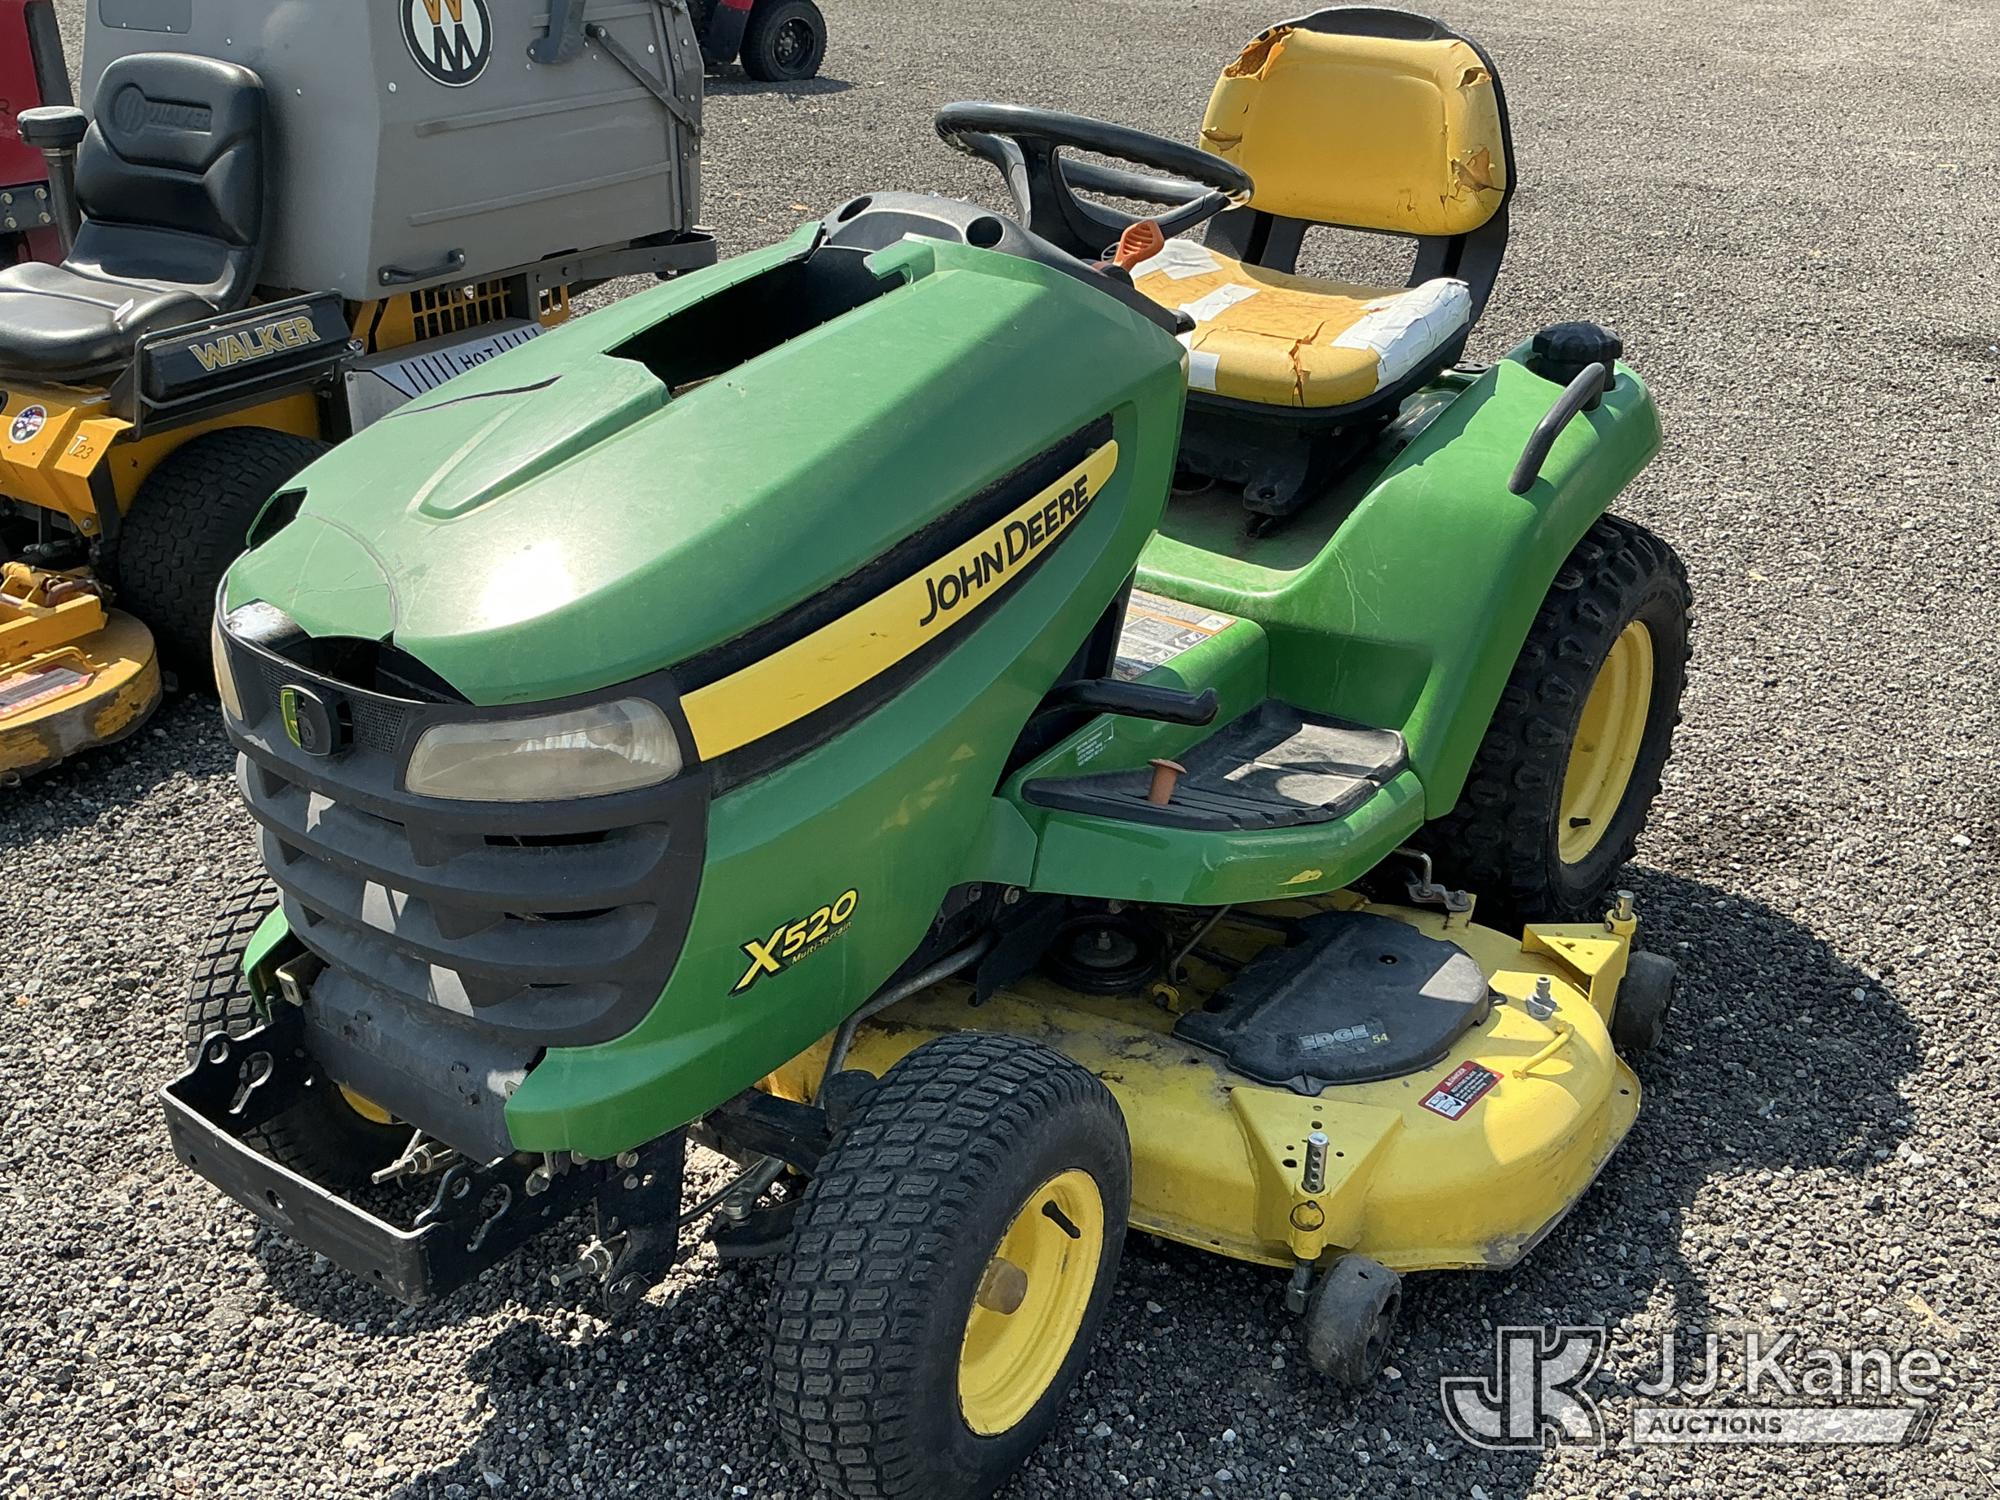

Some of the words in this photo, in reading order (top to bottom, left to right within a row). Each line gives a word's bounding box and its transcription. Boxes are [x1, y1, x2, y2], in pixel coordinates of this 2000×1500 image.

[188, 316, 321, 371] WALKER
[459, 348, 494, 371] HOT
[919, 541, 1004, 627] JOHN
[1003, 473, 1089, 566] DEERE
[730, 888, 858, 994] X520
[1299, 1024, 1369, 1050] EDGE
